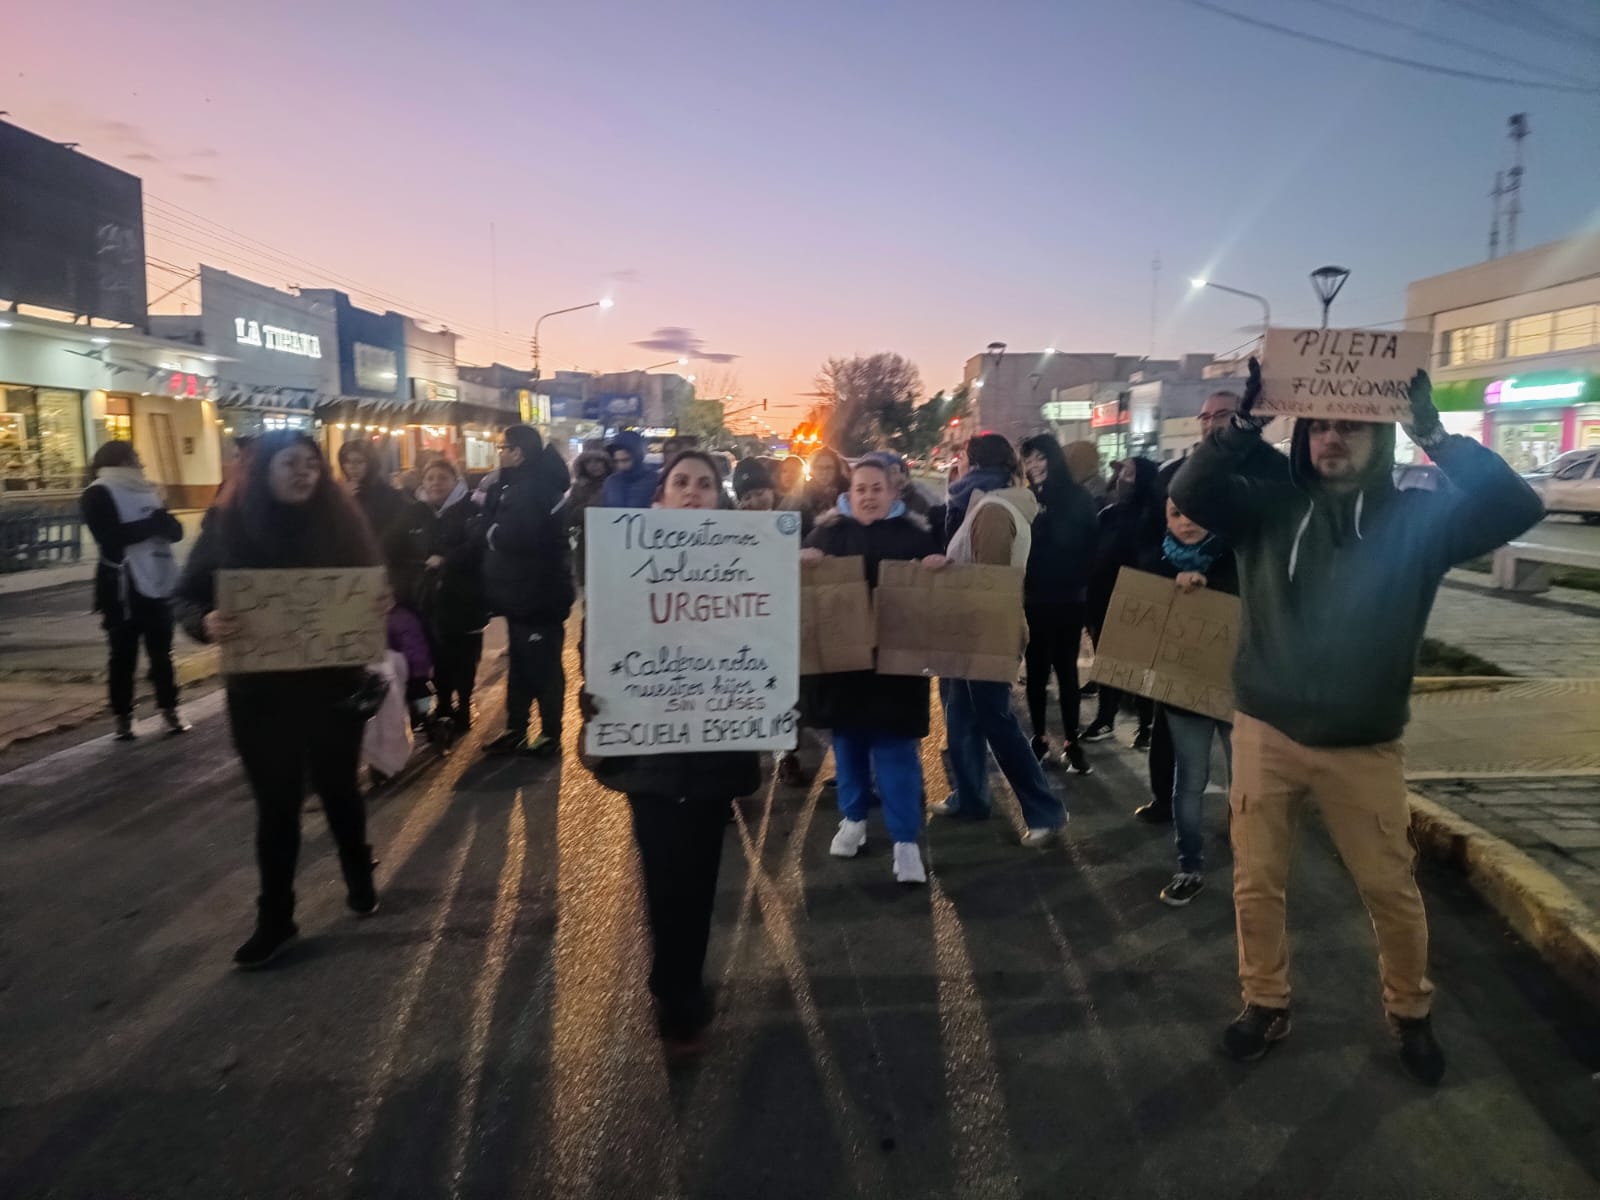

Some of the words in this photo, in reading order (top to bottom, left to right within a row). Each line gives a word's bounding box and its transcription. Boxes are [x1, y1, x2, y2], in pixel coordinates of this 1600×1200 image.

[234, 317, 262, 346] LA
[1293, 329, 1398, 359] PILETA
[1315, 356, 1360, 375] SIN
[650, 592, 771, 624] URGENTE
[1120, 597, 1230, 646] BASTA
[597, 722, 690, 746] ESCUELA
